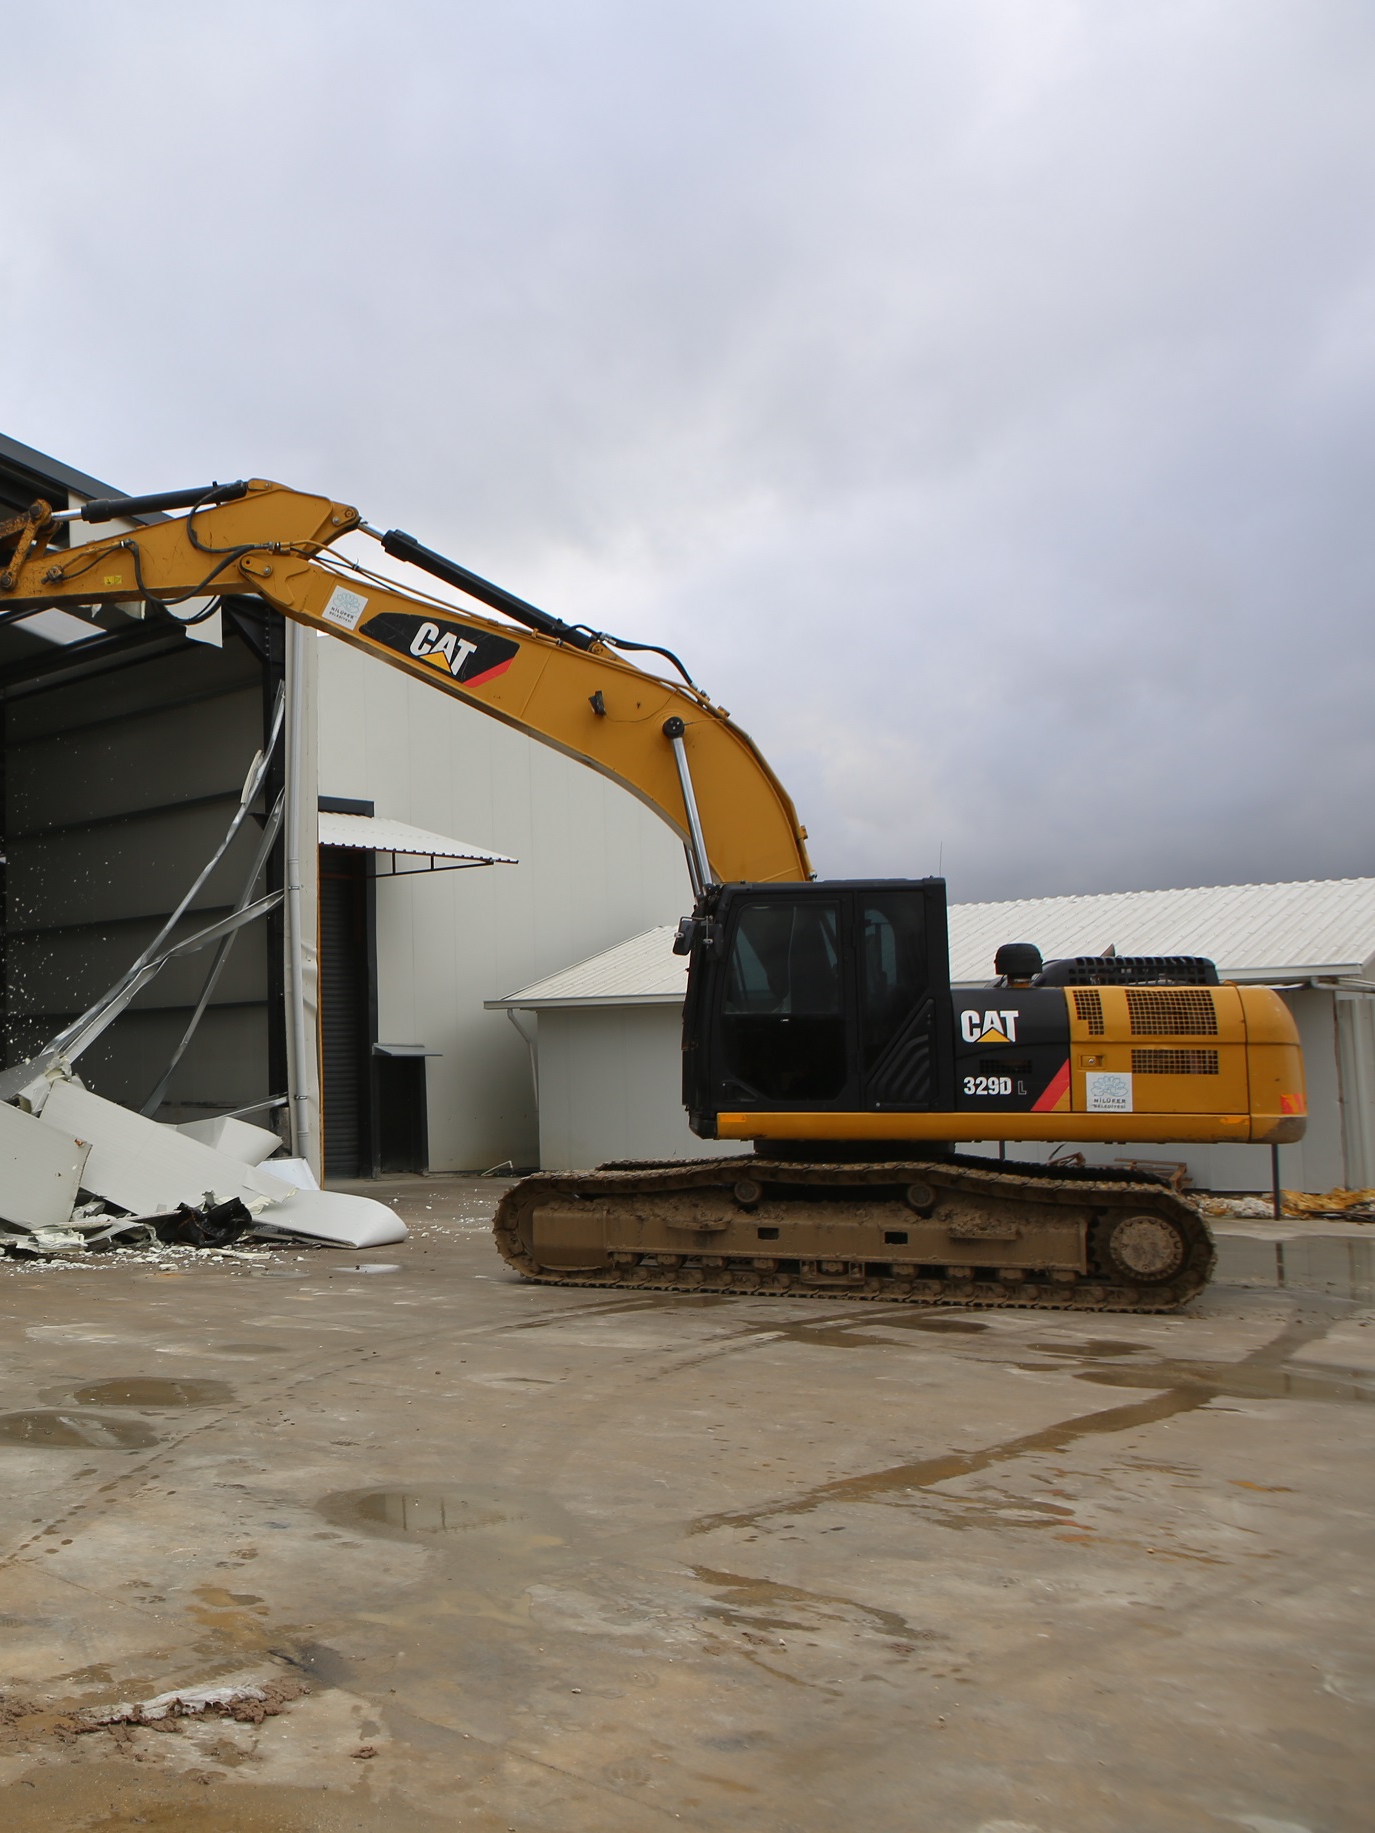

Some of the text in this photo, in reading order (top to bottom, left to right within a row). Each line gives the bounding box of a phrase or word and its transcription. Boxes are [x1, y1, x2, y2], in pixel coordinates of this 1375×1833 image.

[410, 622, 478, 676] CAT
[960, 1010, 1019, 1043] CAT
[963, 1077, 1012, 1095] 329D
